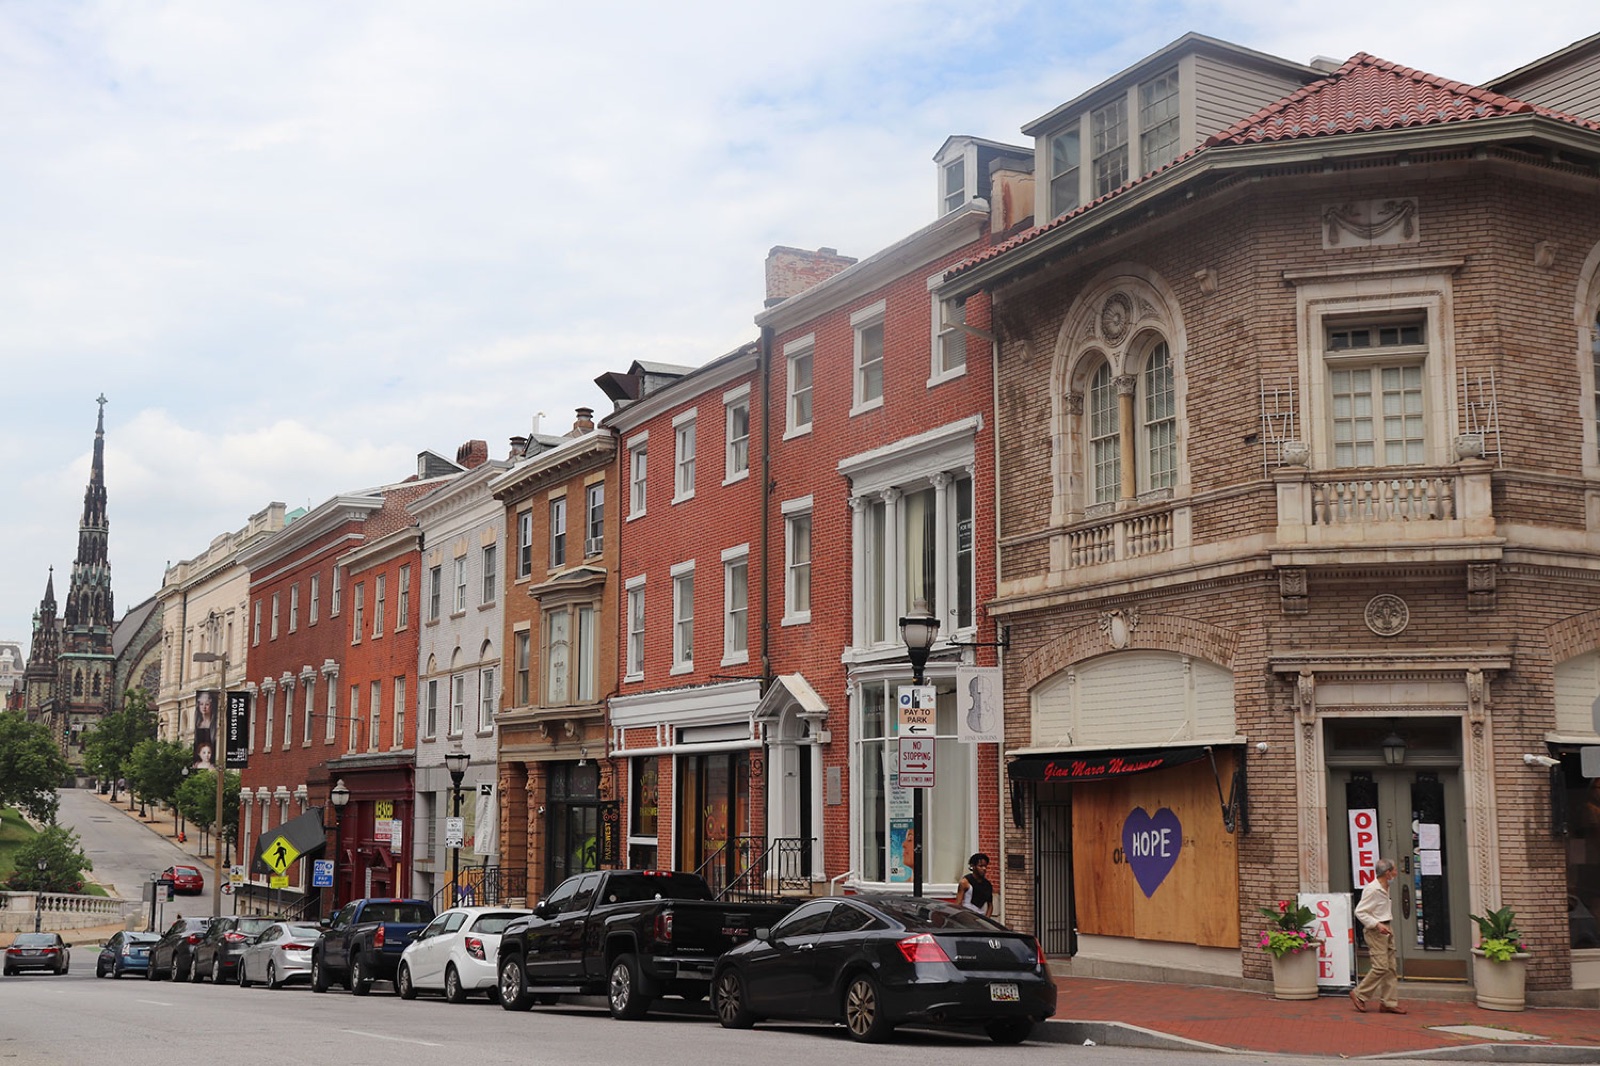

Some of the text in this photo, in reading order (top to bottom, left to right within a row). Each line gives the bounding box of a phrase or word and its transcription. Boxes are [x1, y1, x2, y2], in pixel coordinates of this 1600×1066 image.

[903, 752, 931, 761] STOPPING
[912, 741, 922, 750] NO
[1044, 762, 1069, 781] Gian
[1071, 761, 1105, 777] Marco
[1133, 828, 1172, 857] HOPE
[1354, 812, 1377, 886] OPEN
[1315, 900, 1335, 980] SALE
